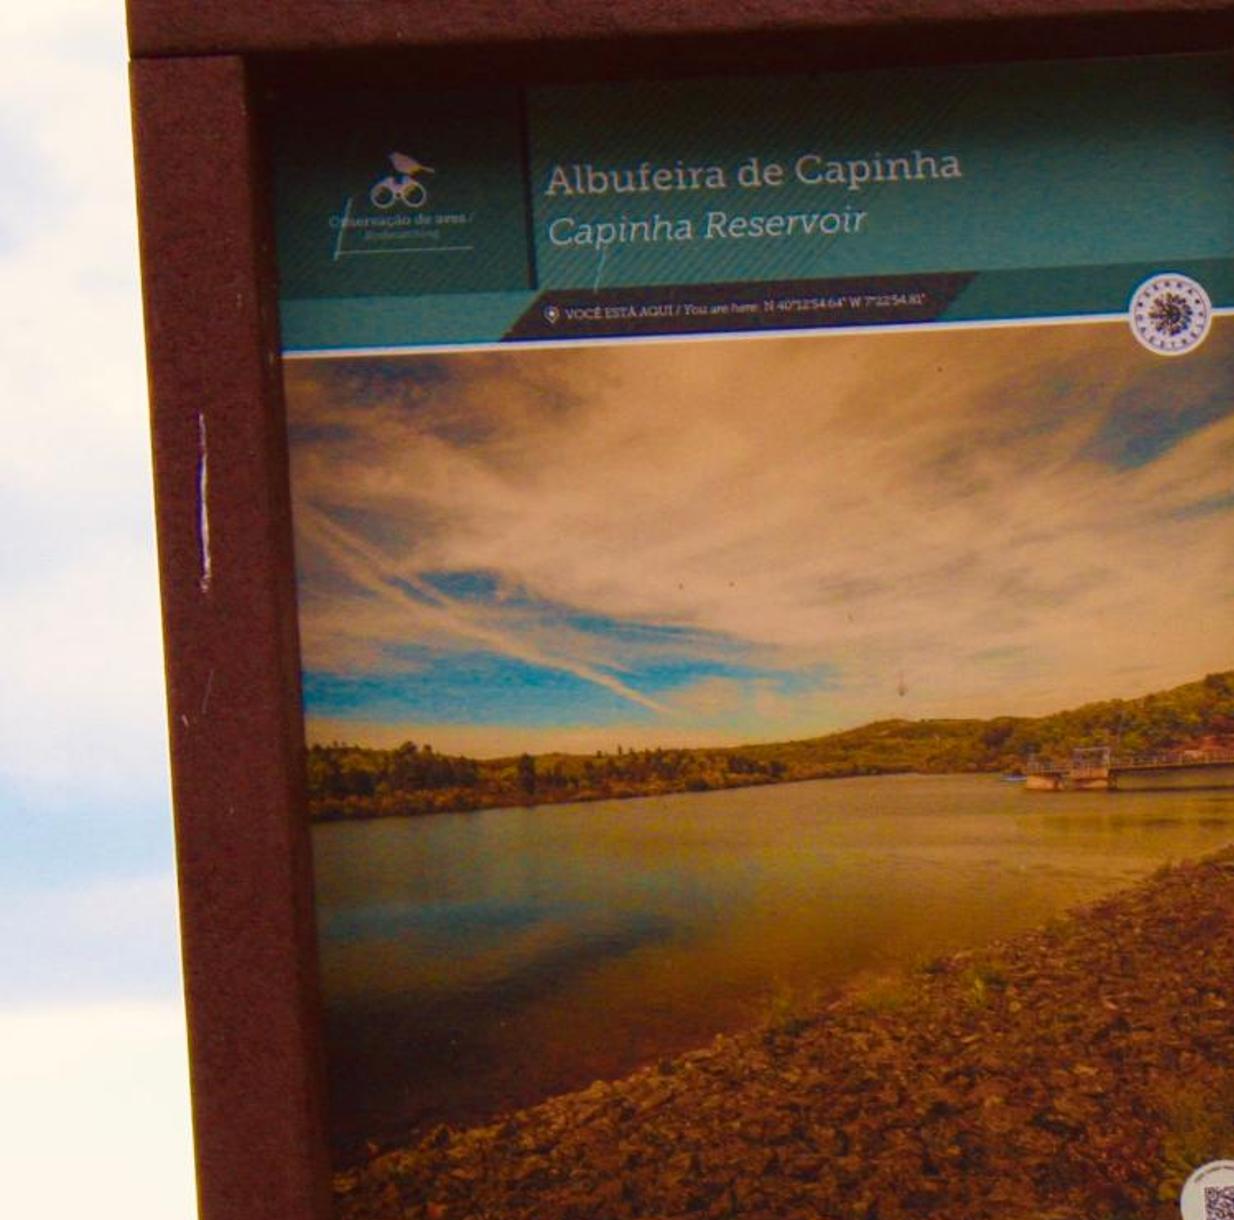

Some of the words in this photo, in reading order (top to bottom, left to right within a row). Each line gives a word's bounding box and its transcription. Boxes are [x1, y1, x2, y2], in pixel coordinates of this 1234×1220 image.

[544, 159, 727, 196] Albufeira
[737, 155, 784, 188] de
[794, 148, 963, 189] Capinha
[547, 210, 694, 252] Capinha
[704, 205, 868, 241] Reservoir
[683, 301, 706, 316] You
